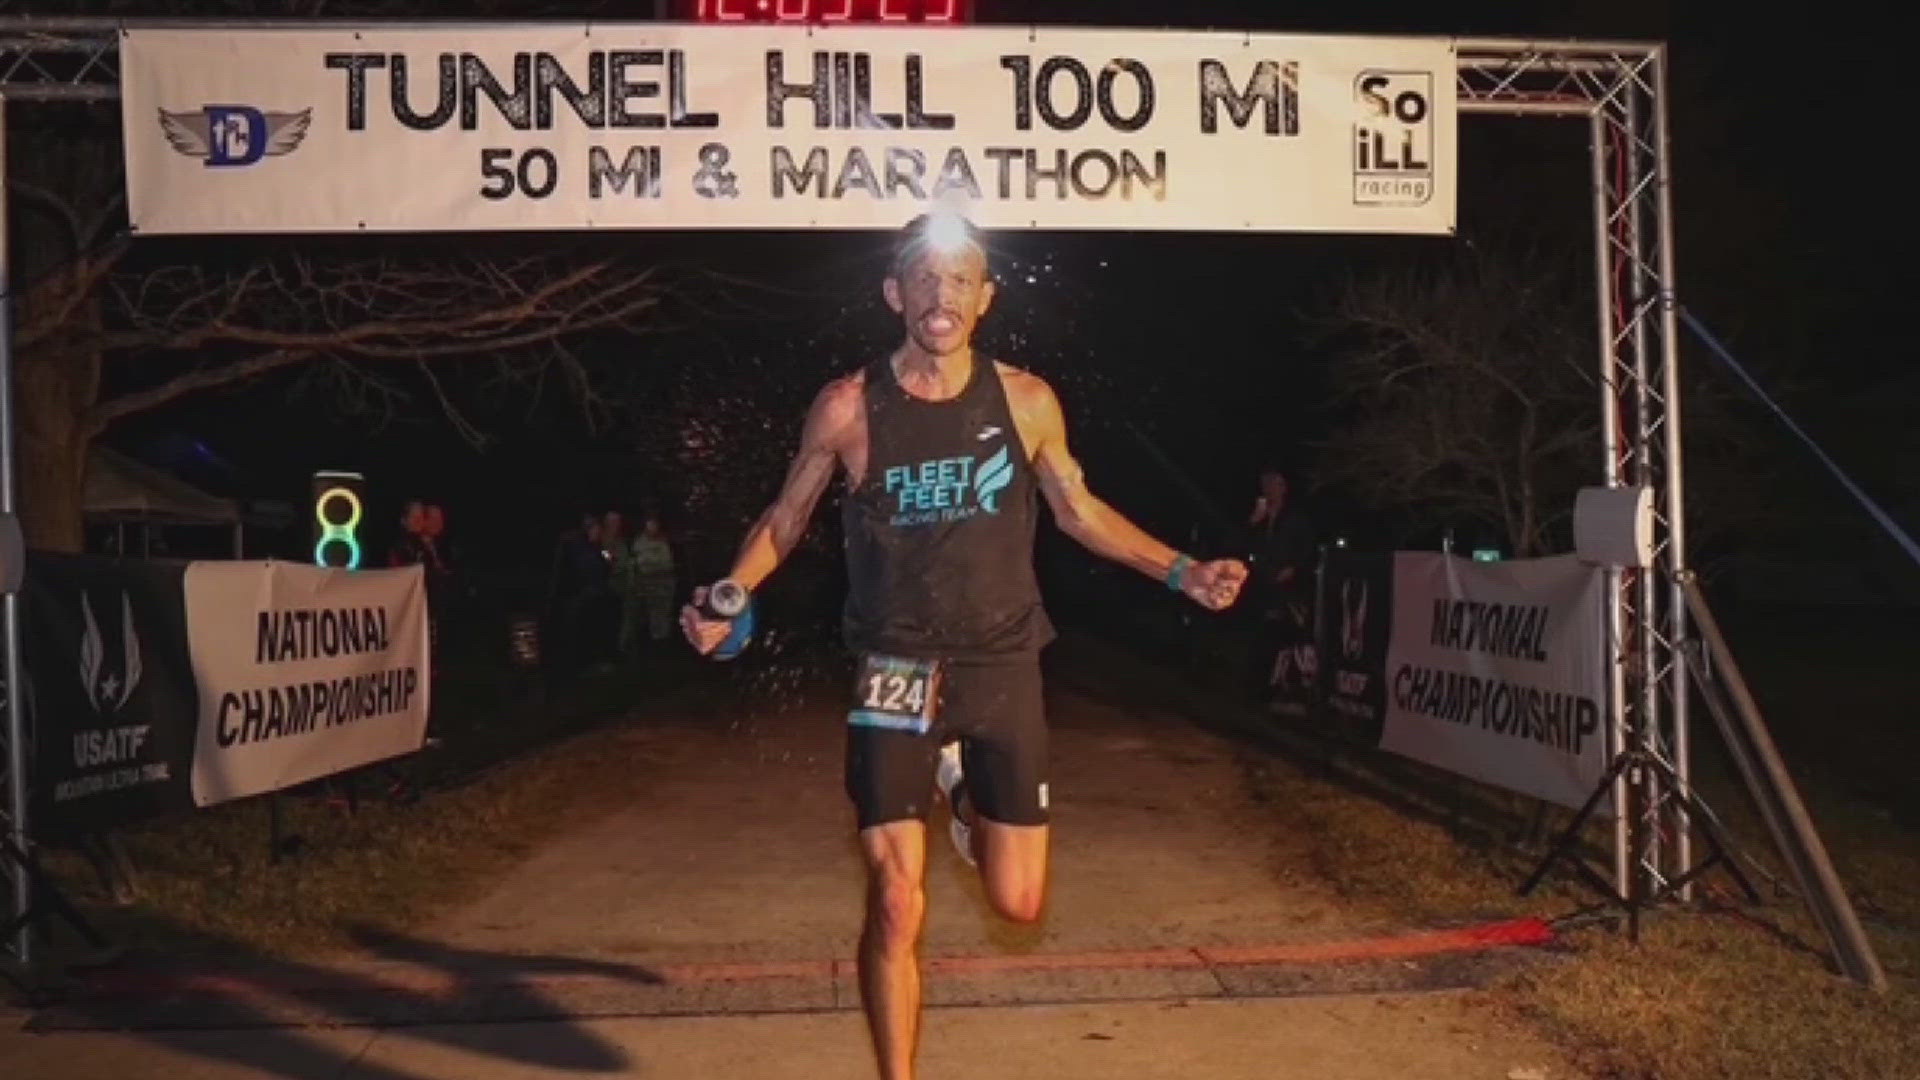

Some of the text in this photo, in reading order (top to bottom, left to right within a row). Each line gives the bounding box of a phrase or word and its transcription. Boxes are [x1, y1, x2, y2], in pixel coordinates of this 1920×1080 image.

[325, 50, 1300, 136] TUNNEL HILL 100 MI
[1360, 76, 1427, 124] So
[480, 143, 1166, 202] 50 MI & MARATHON
[1360, 180, 1426, 198] racing
[885, 456, 975, 494] FLEET
[899, 482, 968, 512] FEET
[256, 605, 389, 665] NATIONAL
[1430, 599, 1550, 662] NATIONAL
[215, 666, 418, 749] CHAMPIONSHIP
[863, 673, 924, 713] 124
[1394, 663, 1600, 756] CHAMPIONSHIP
[73, 724, 151, 769] USATF
